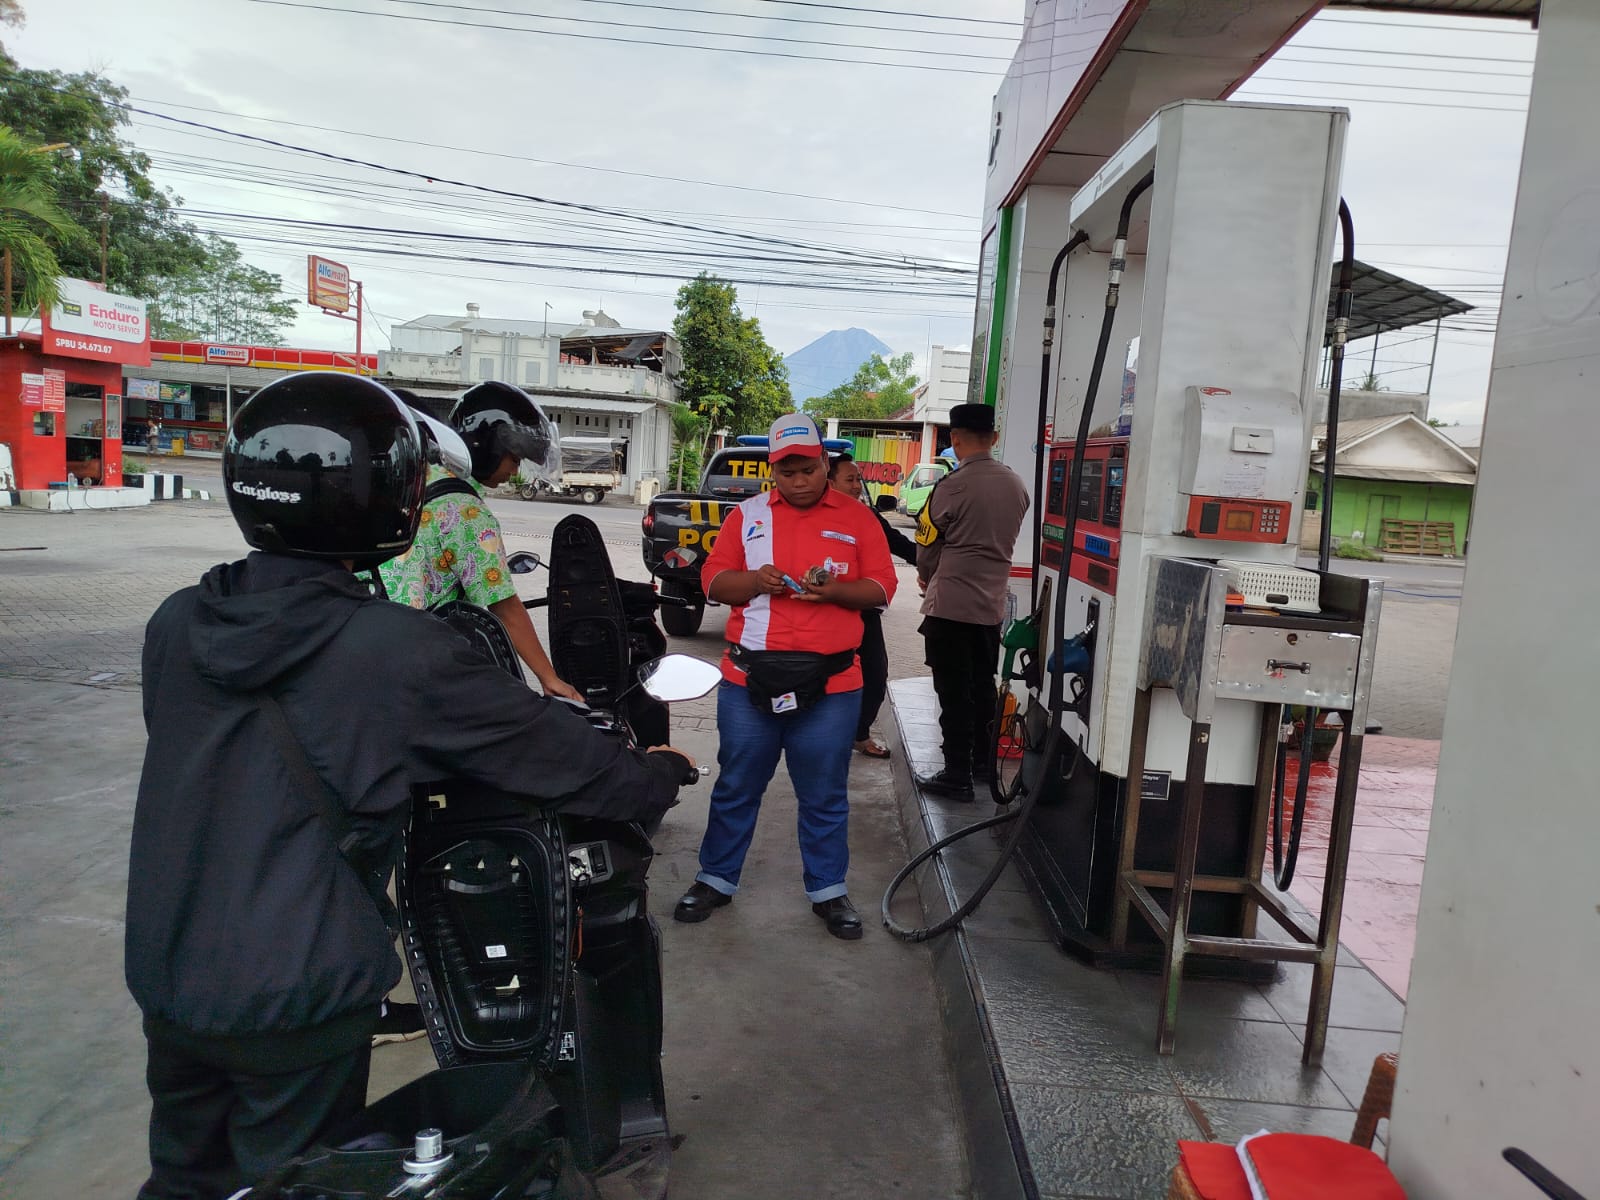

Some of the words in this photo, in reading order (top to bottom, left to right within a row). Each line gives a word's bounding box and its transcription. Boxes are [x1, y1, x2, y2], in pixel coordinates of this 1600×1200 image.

[318, 263, 346, 282] Alfamart
[89, 303, 140, 325] Enduro
[93, 319, 116, 331] MOTOR
[117, 324, 140, 335] SERVICE
[55, 338, 76, 349] SPBU
[77, 341, 112, 354] 54.673.07
[208, 347, 245, 358] Alfamart
